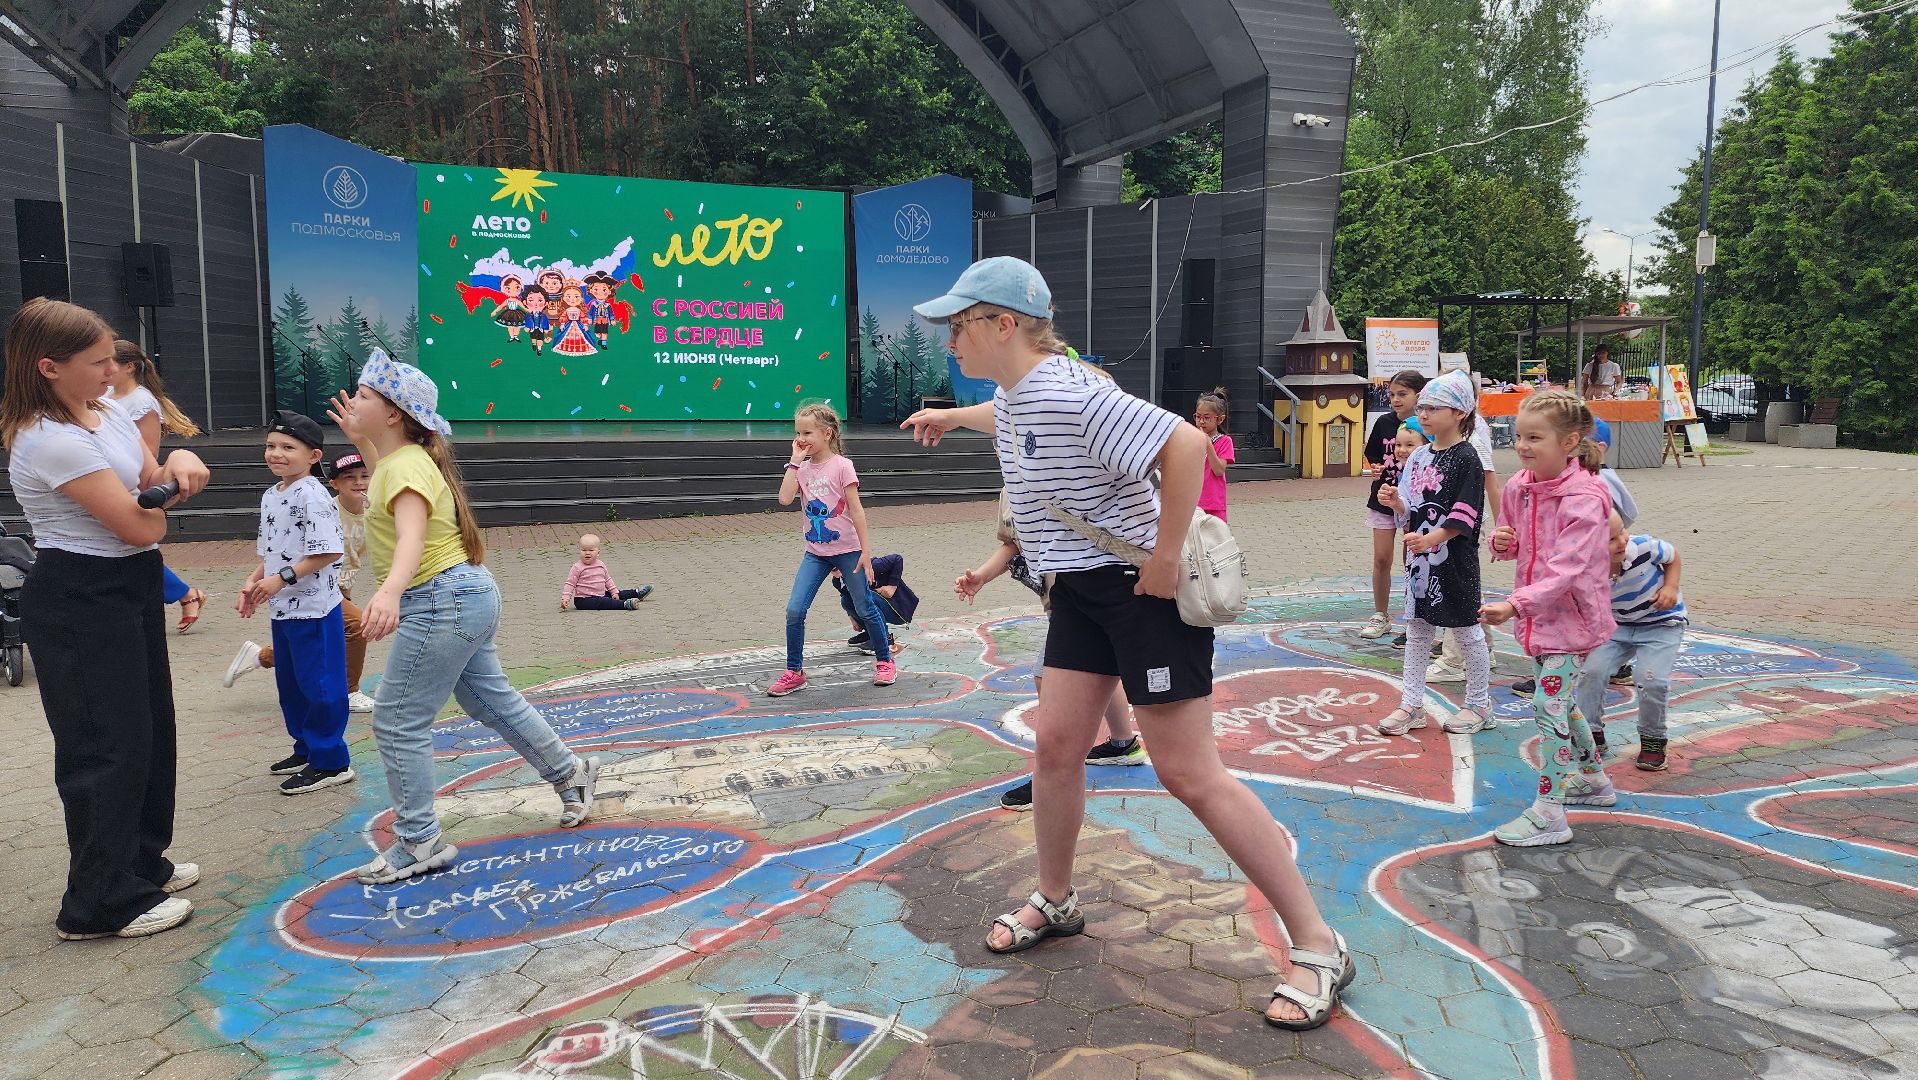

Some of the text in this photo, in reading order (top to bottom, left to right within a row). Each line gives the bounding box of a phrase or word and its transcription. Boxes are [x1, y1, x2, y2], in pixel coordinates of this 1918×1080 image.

[324, 213, 370, 226] ПАРКИ
[292, 222, 401, 241] ПОДМОСКОВЬЯ
[896, 245, 930, 253] ПАРКИ
[876, 255, 949, 264] ДОМОДЕДОВО
[652, 298, 784, 320] С РОССИЕЙ
[653, 325, 764, 349] В СЕРДЦЕ
[653, 353, 779, 367] 12 ИЮНЯ (Четверг)
[336, 454, 361, 468] MARVEL
[489, 840, 745, 920] ПРЖЕВАЛЬСКОГО
